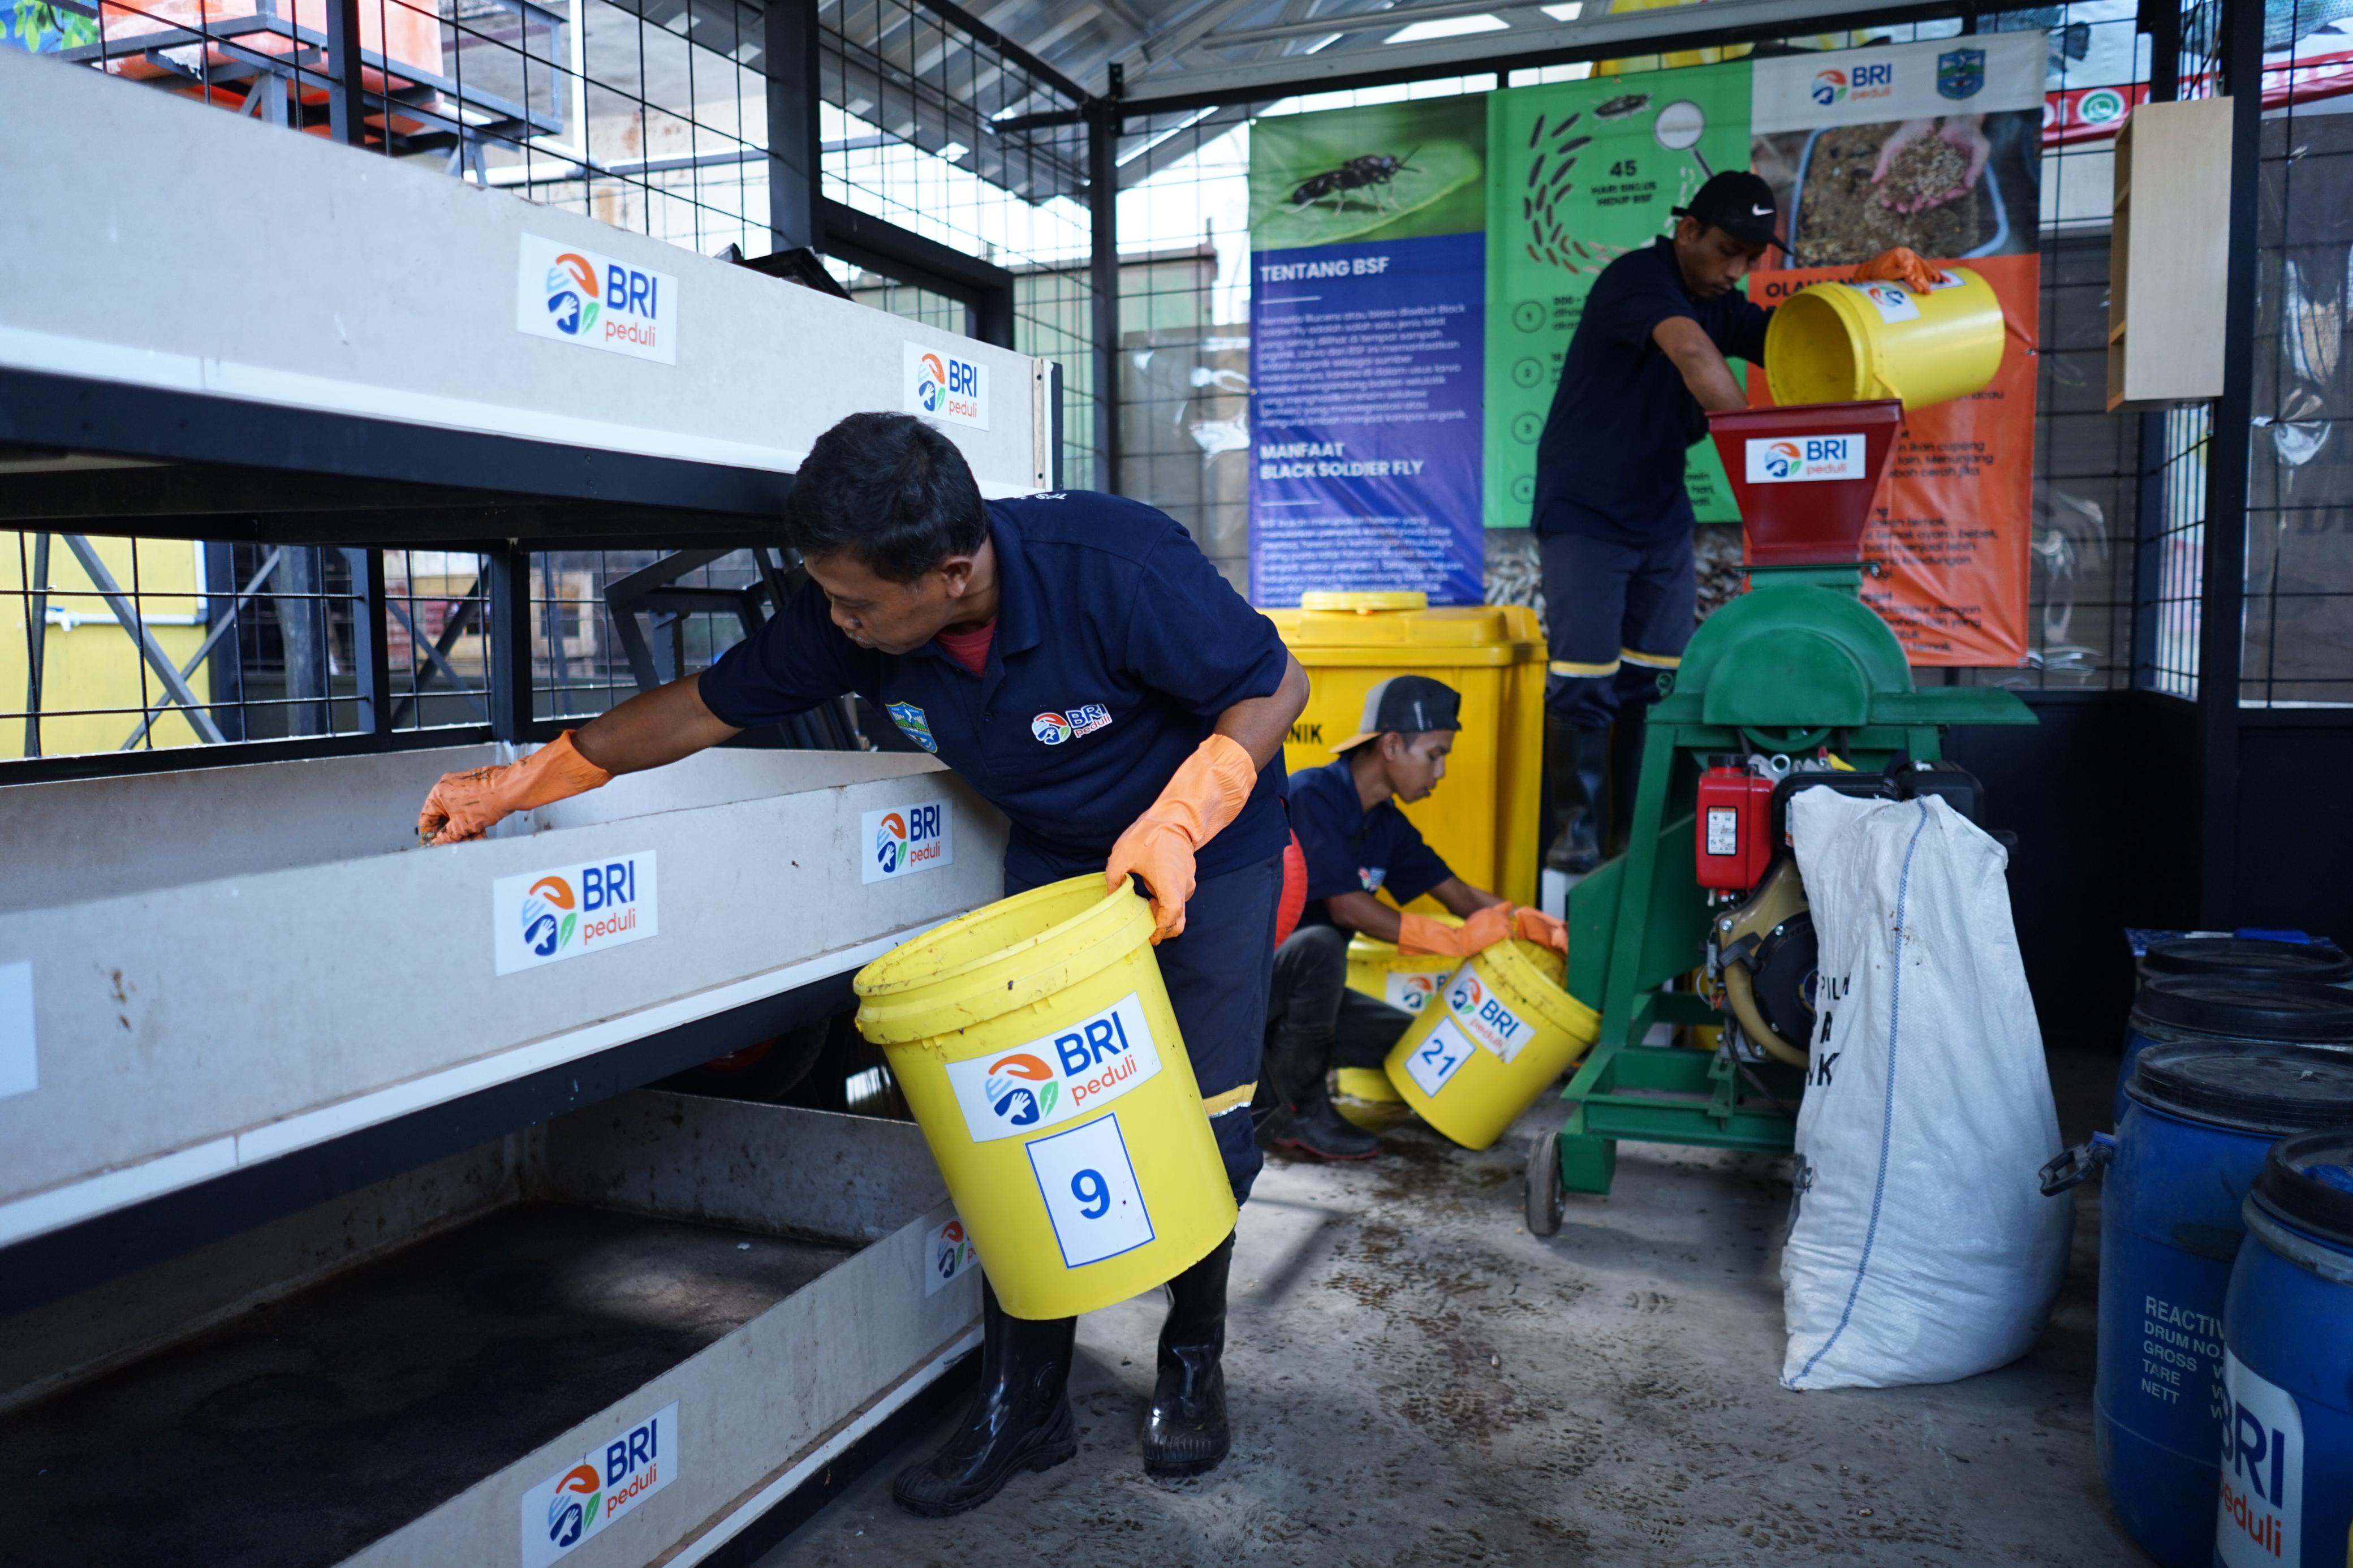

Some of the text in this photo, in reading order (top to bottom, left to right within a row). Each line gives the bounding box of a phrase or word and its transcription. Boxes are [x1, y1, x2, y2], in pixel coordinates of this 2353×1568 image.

[1852, 64, 1891, 88] BRI
[1610, 160, 1636, 177] 45
[1260, 257, 1390, 282] TENTANG BSF
[607, 264, 657, 320] BRI
[605, 321, 656, 347] peduli
[950, 359, 977, 398] BRI
[949, 400, 977, 419] peduli
[1260, 442, 1344, 460] MANFAAT
[1807, 440, 1847, 462] BRI
[1260, 460, 1424, 480] BLACK SOLDIER FLY
[1806, 460, 1847, 476] peduli
[1066, 703, 1109, 729] BRI
[1074, 714, 1113, 738] peduli
[911, 804, 940, 842] BRI
[910, 840, 940, 867] peduli
[583, 860, 635, 912] BRI
[584, 908, 636, 945] peduli
[1479, 998, 1520, 1039] BRI
[1054, 1010, 1130, 1078] BRI
[1421, 1038, 1456, 1077] 21
[1071, 1054, 1137, 1107] peduli
[1071, 1168, 1110, 1220] 9
[2144, 1320, 2189, 1350] DRUM
[2143, 1340, 2197, 1372] GROSS
[2142, 1358, 2181, 1386] TARE
[2141, 1378, 2180, 1405] NETT
[607, 1418, 657, 1488] BRI
[607, 1462, 657, 1518] peduli
